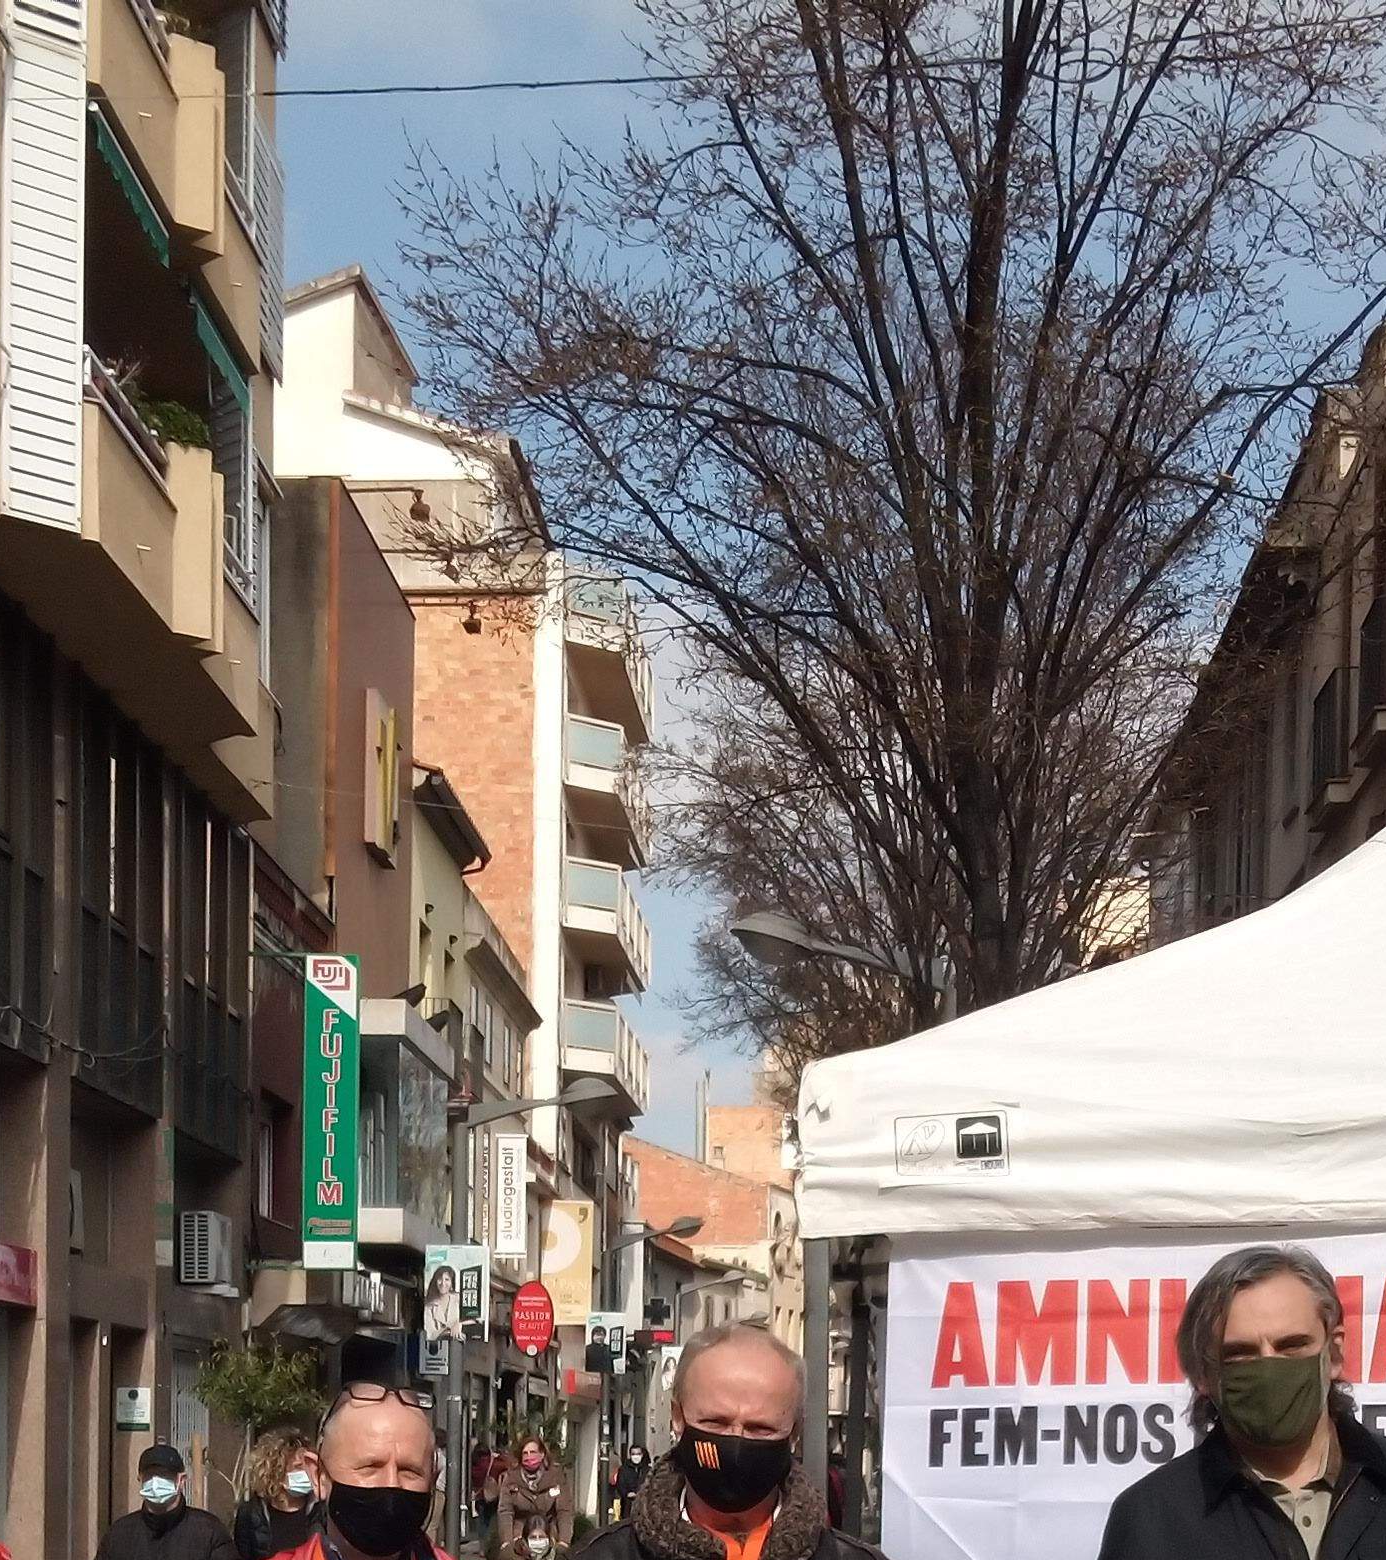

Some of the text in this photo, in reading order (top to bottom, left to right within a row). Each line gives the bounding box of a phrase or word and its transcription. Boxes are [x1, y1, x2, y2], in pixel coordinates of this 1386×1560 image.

[316, 1008, 343, 1205] FUJIFILM
[514, 1310, 551, 1321] PASSION
[928, 1403, 1176, 1469] FEM-NOS
